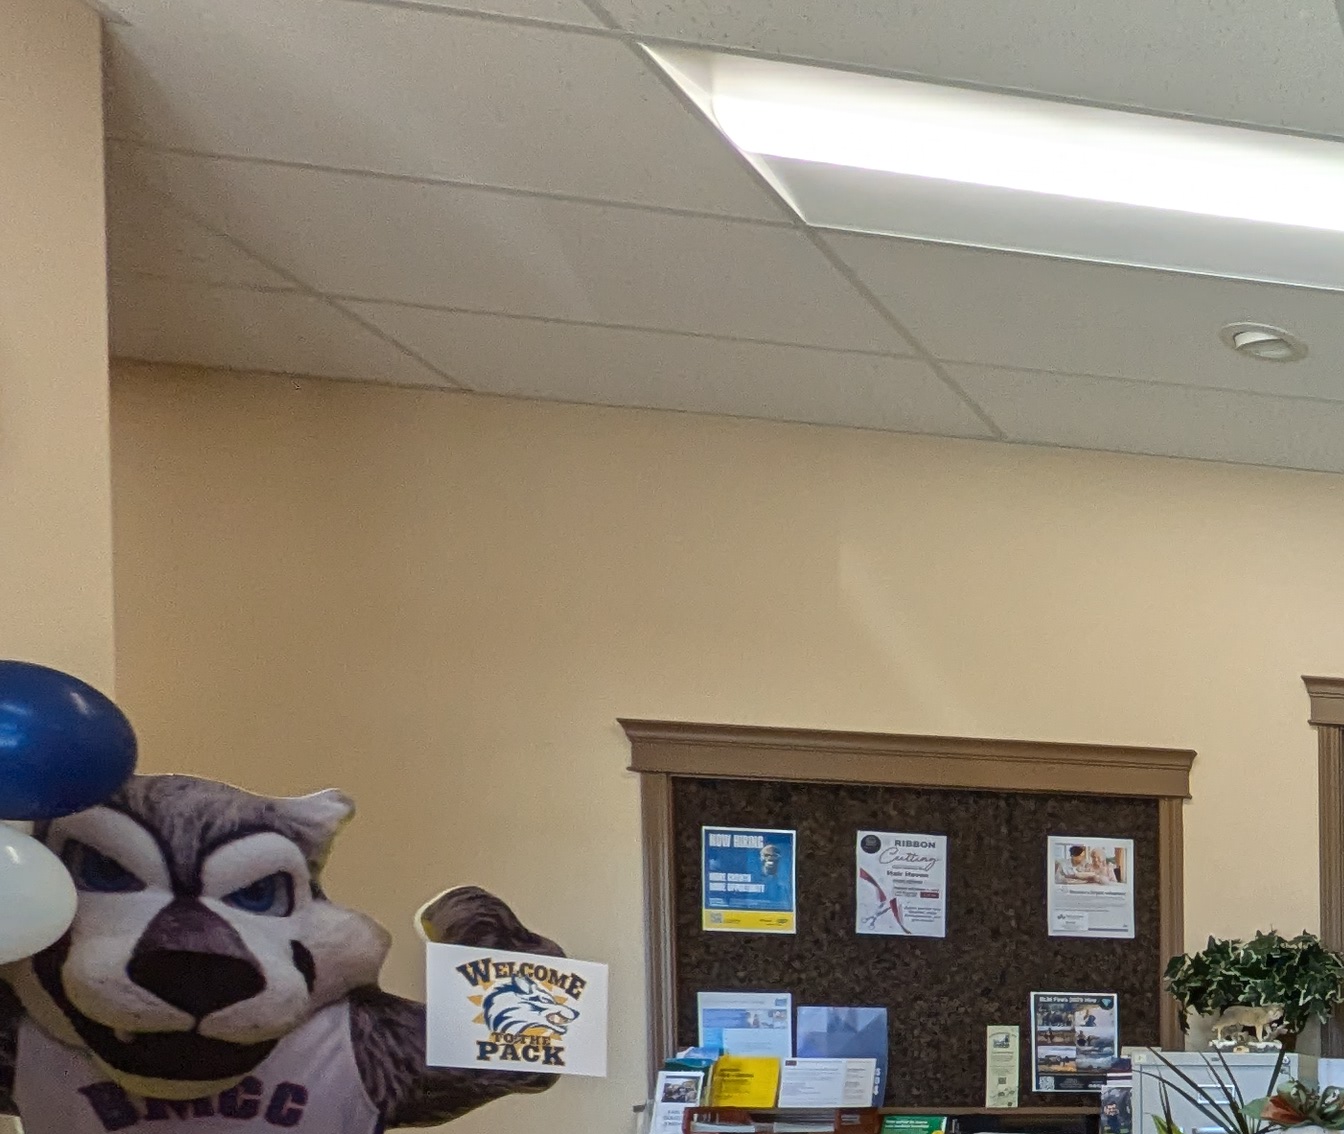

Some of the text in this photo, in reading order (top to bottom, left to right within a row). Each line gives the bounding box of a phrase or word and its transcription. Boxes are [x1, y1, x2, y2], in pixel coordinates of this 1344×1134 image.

[894, 840, 936, 848] RIBBON
[879, 847, 939, 872] Cutting
[455, 957, 588, 1000] WELCOME
[491, 1031, 551, 1046] TO THE
[476, 1040, 566, 1066] PACK
[78, 1075, 309, 1132] BMCC
